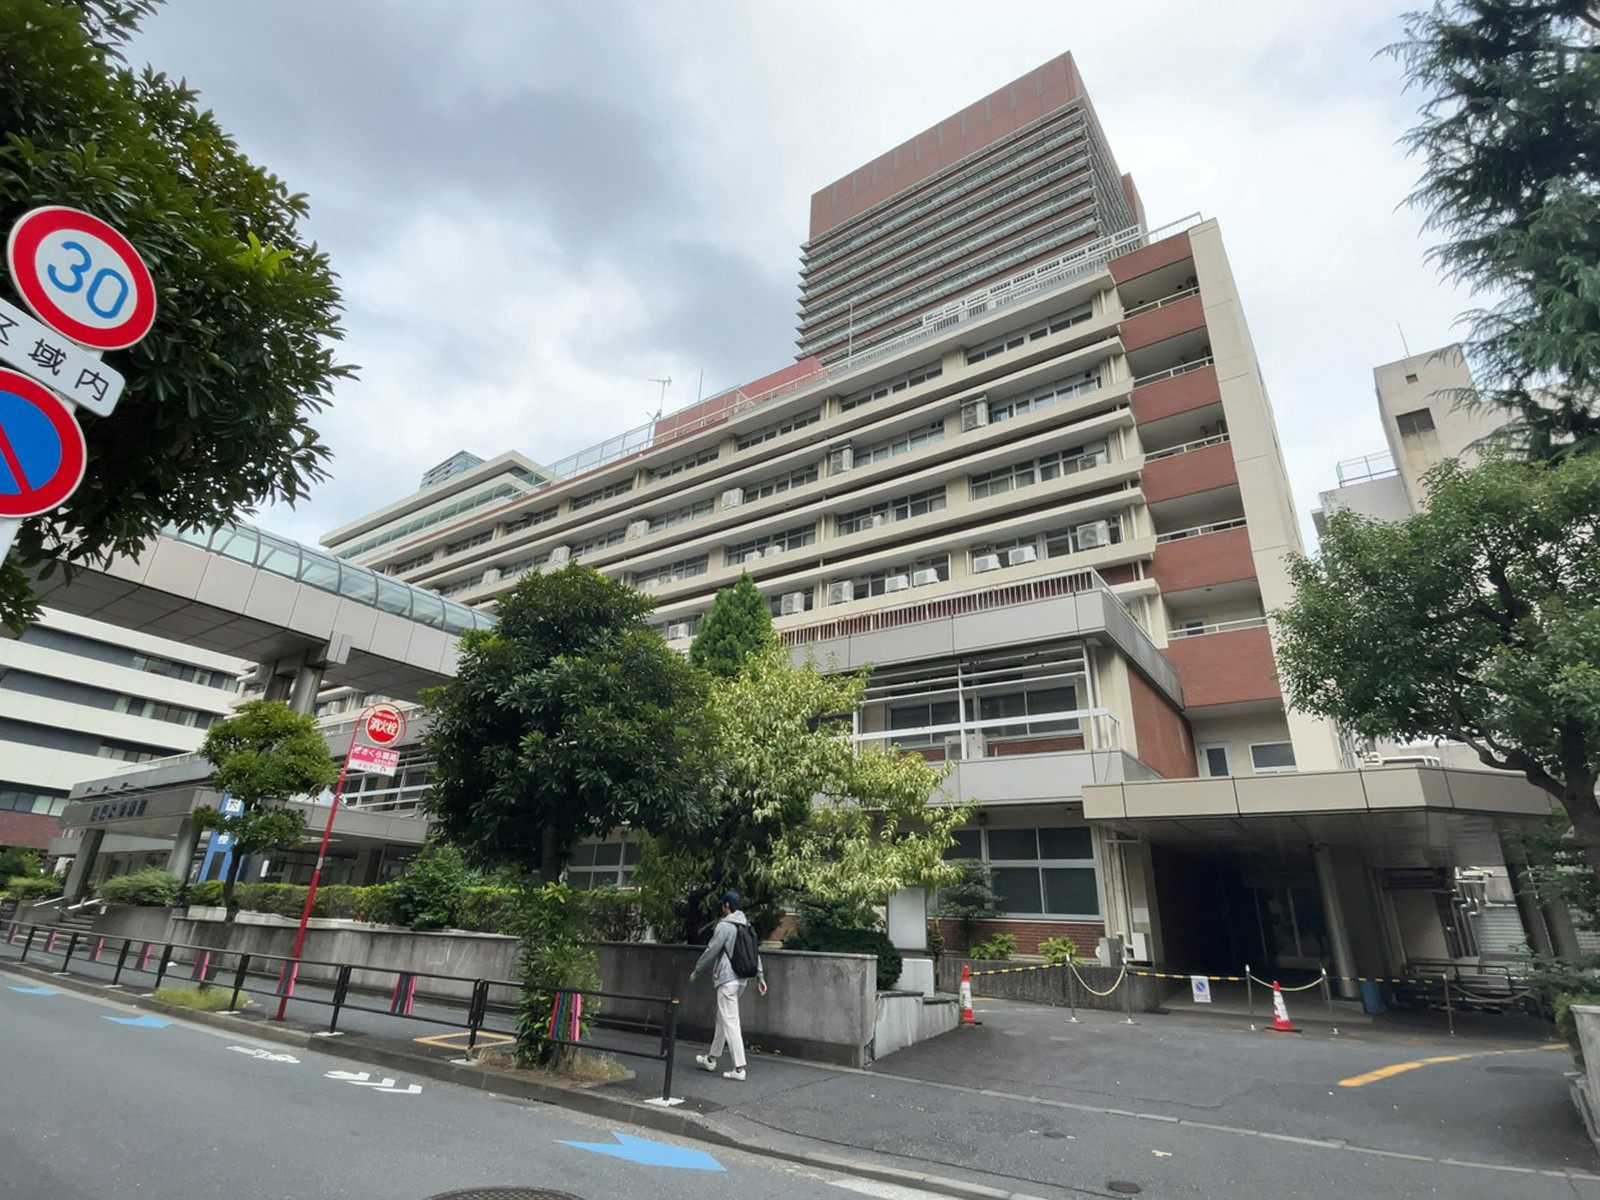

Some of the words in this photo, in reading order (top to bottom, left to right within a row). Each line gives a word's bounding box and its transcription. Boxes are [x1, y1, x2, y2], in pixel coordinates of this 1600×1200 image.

[47, 241, 129, 319] 30
[369, 717, 398, 735] 消火栓
